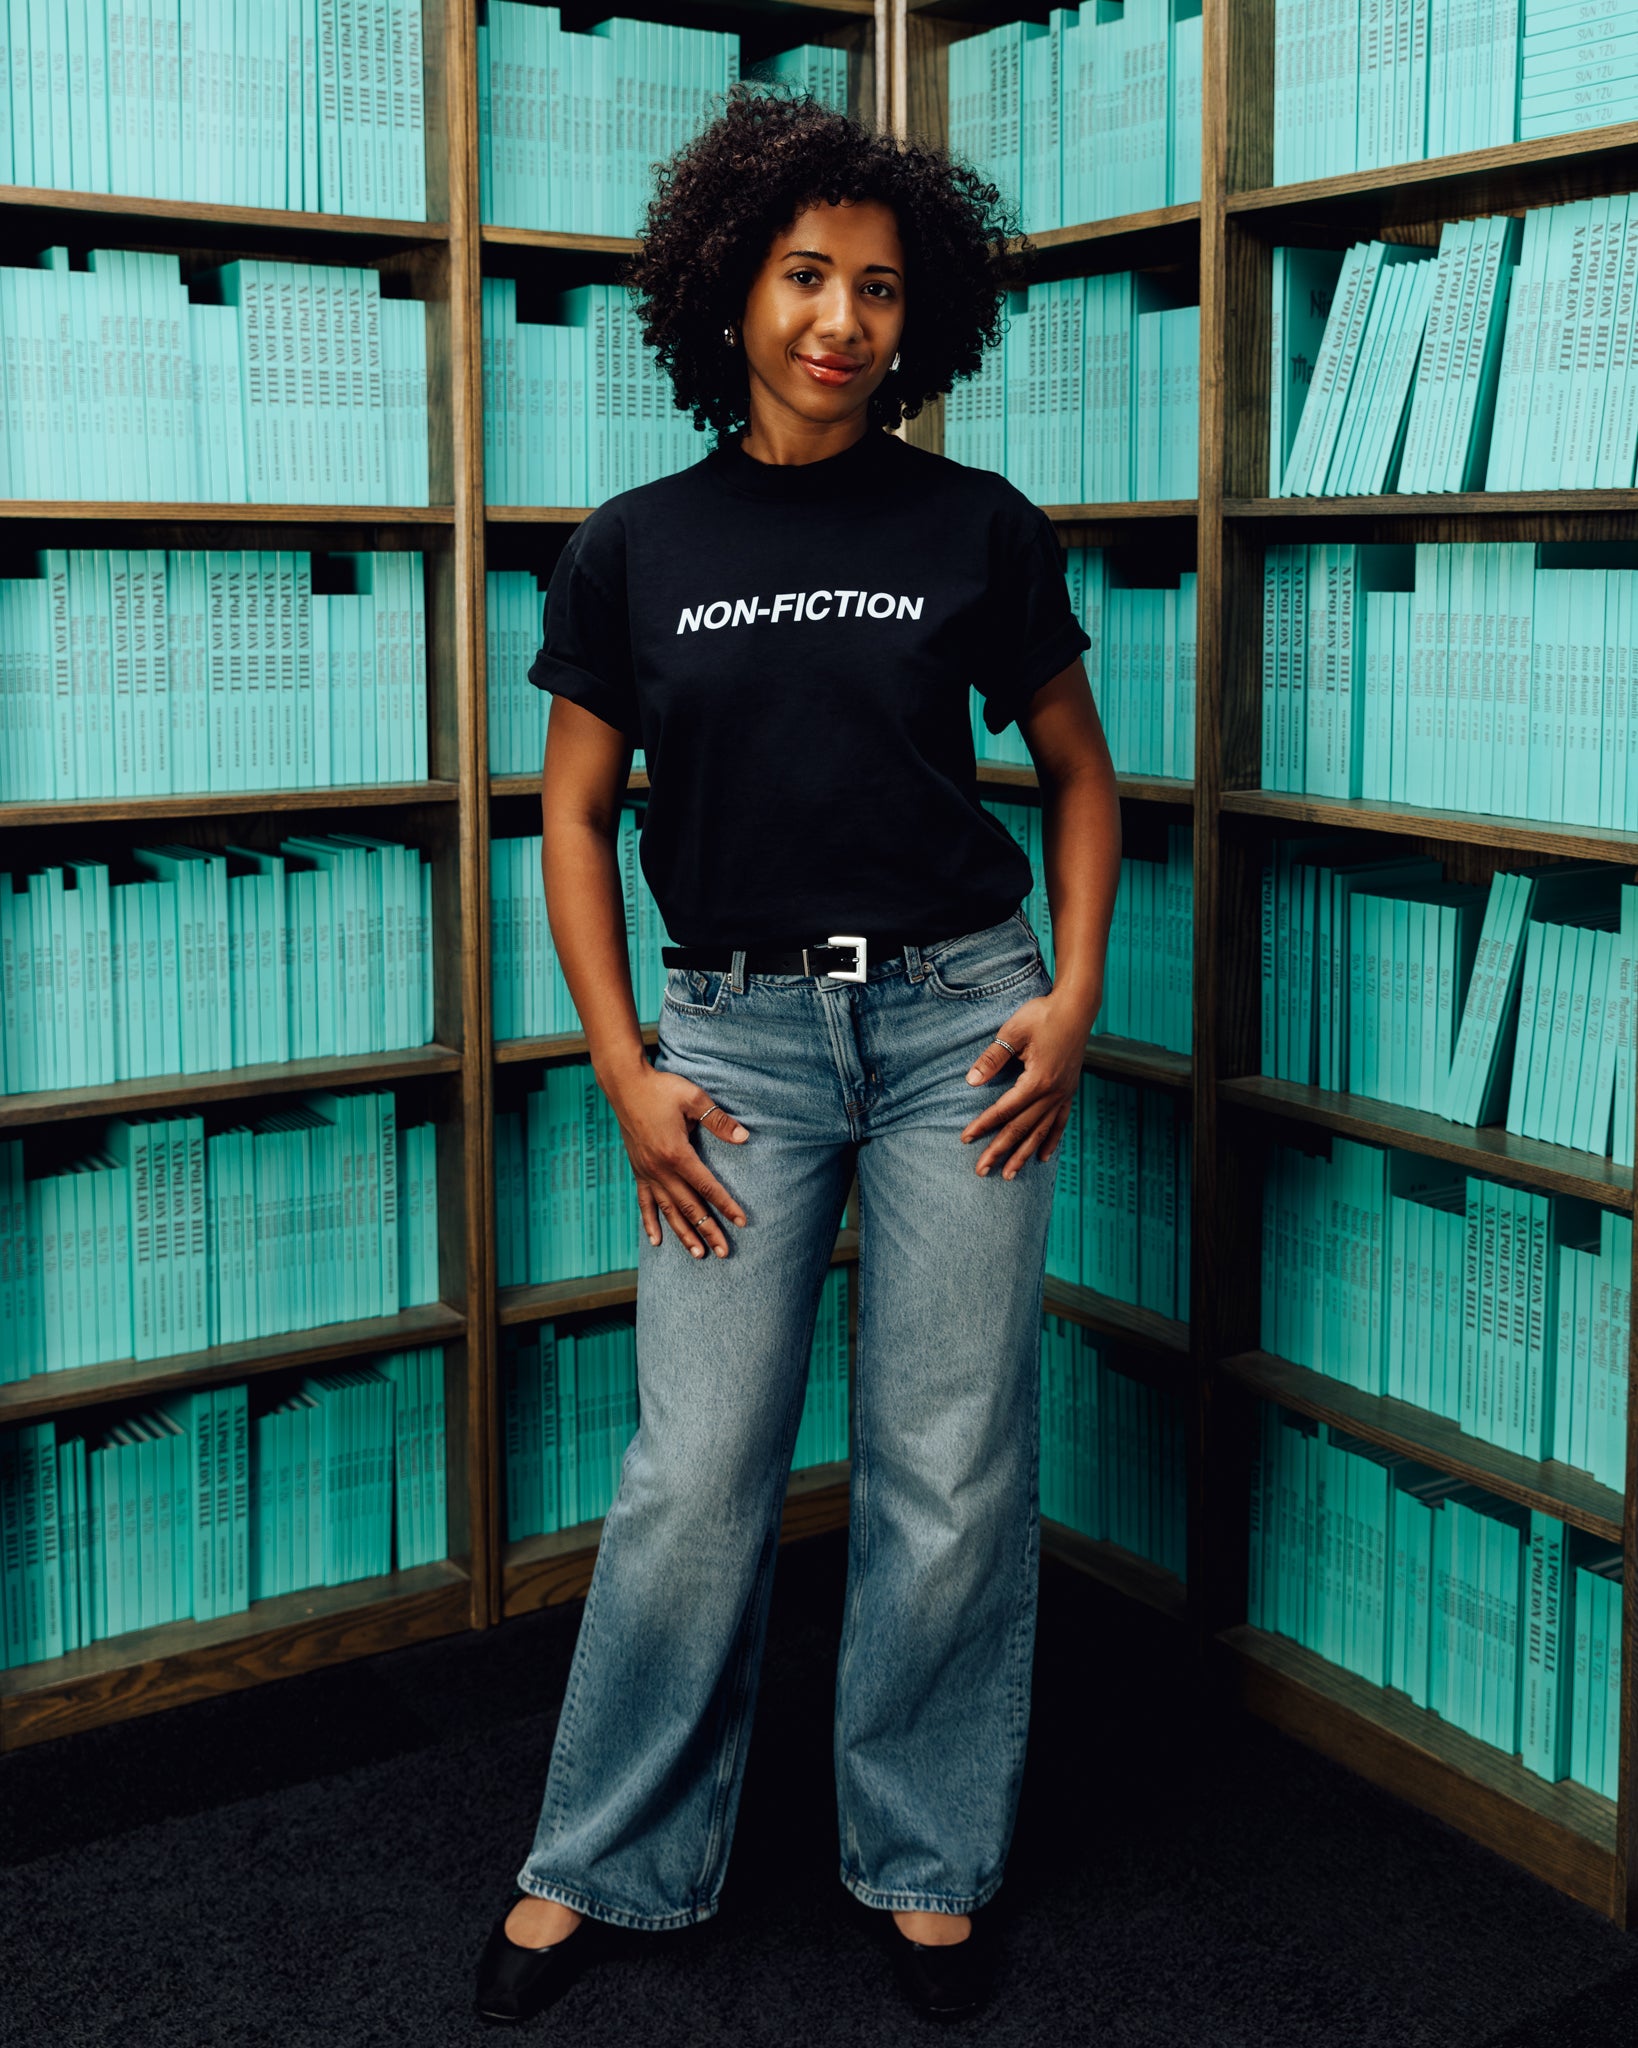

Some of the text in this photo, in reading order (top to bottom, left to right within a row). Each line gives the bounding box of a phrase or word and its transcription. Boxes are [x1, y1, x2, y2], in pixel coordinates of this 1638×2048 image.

[358, 3, 371, 127] NAPOLEON HILL
[374, 6, 387, 128] NAPOLEON HILL
[392, 9, 405, 130] NAPOLEON HILL
[409, 11, 421, 132] NAPOLEON HILL
[1575, 65, 1614, 83] SUN TZU
[1577, 22, 1615, 40] SUN TZU
[1578, 44, 1616, 61] SUN TZU
[1574, 87, 1613, 104] SUN TZU
[1575, 108, 1613, 124] SUN TZU
[247, 283, 261, 406] NAPOLEON HILL
[264, 284, 279, 406] NAPOLEON HILL
[281, 284, 296, 407] NAPOLEON HILL
[316, 287, 330, 408] NAPOLEON HILL
[350, 289, 363, 409] NAPOLEON HILL
[368, 291, 381, 410] NAPOLEON HILL
[1321, 267, 1361, 396] NAPOLEON HILL
[1336, 264, 1376, 394] NAPOLEON HILL
[1418, 248, 1452, 386] NAPOLEON HILL
[1434, 245, 1467, 385] NAPOLEON HILL
[1450, 242, 1483, 382] NAPOLEON HILL
[1466, 240, 1500, 382] NAPOLEON HILL
[1558, 226, 1586, 375] NAPOLEON HILL
[1576, 223, 1604, 373] NAPOLEON HILL
[1593, 222, 1621, 373] NAPOLEON HILL
[1612, 218, 1638, 371] NAPOLEON HILL
[596, 306, 606, 419] NAPOLEON HILL
[212, 572, 224, 695] NAPOLEON HILL
[230, 572, 242, 695] NAPOLEON HILL
[265, 572, 276, 694] NAPOLEON HILL
[676, 590, 924, 635] NON-FICTION
[1265, 566, 1276, 692] NAPOLEON HILL
[1279, 566, 1290, 692] NAPOLEON HILL
[1293, 567, 1304, 693] NAPOLEON HILL
[1326, 567, 1337, 695] NAPOLEON HILL
[1340, 567, 1352, 697] NAPOLEON HILL
[1521, 984, 1534, 1028] SUN TZU
[1537, 985, 1552, 1031] SUN TZU
[1554, 990, 1569, 1034] SUN TZU
[1570, 993, 1585, 1038] SUN TZU
[1587, 996, 1602, 1041] SUN TZU
[1604, 1000, 1618, 1045] SUN TZU
[154, 1143, 167, 1263] NAPOLEON HILL
[173, 1140, 186, 1260] NAPOLEON HILL
[1465, 1200, 1478, 1330] NAPOLEON HILL
[1482, 1204, 1495, 1336] NAPOLEON HILL
[1498, 1208, 1511, 1342] NAPOLEON HILL
[1513, 1213, 1527, 1346] NAPOLEON HILL
[1530, 1218, 1544, 1352] NAPOLEON HILL
[1531, 1532, 1543, 1621] NAPOLEON
[1544, 1539, 1559, 1673] NAPOLEON HILL
[1529, 1623, 1541, 1665] HILL
